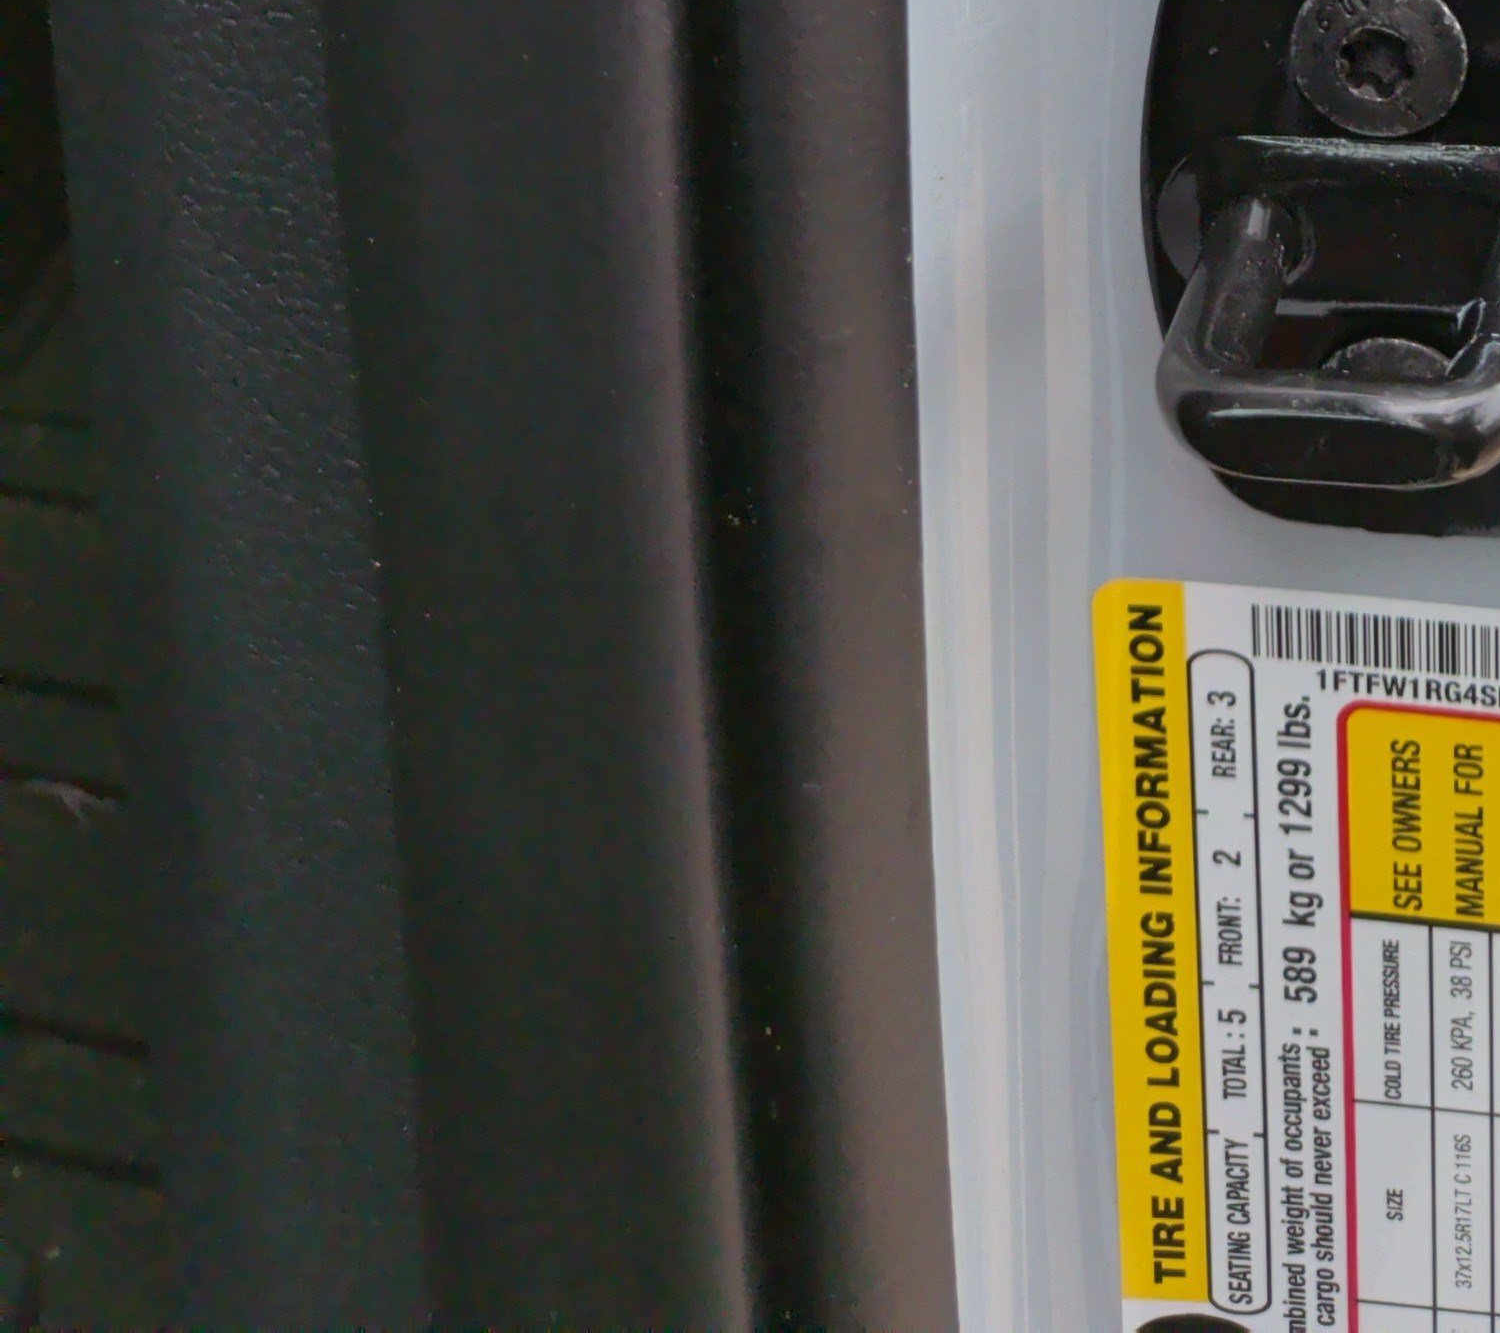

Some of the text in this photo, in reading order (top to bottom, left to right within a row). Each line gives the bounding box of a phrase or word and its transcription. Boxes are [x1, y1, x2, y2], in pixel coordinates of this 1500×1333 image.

[1207, 691, 1237, 778] REAR: 3
[1277, 695, 1312, 749] lbs.
[1277, 759, 1312, 835] 1299
[1390, 739, 1422, 910] SEE OWNERS
[1453, 744, 1484, 917] MANUAL FOR
[1212, 850, 1242, 965] FRONT: 2
[1282, 891, 1323, 927] kg
[1288, 849, 1315, 880] or
[1128, 605, 1187, 1283] TIRE AND LOADING INFORMATION
[1282, 946, 1318, 1003] 589
[1218, 1010, 1247, 1099] TOTAL 5
[1382, 940, 1402, 1099] COLD TIRE PRESSURE
[1450, 941, 1475, 1090] 260 KPA, 38 PSI
[1278, 1043, 1308, 1151] occupants
[1280, 1157, 1305, 1178] of
[1307, 1046, 1340, 1326] cargo should never exceed
[1387, 1189, 1403, 1220] SIZE
[1454, 1134, 1472, 1288] 37x12.5R17LT 116S
[1224, 1139, 1252, 1305] SEATING CAPACITY
[1281, 1186, 1309, 1255] weight
